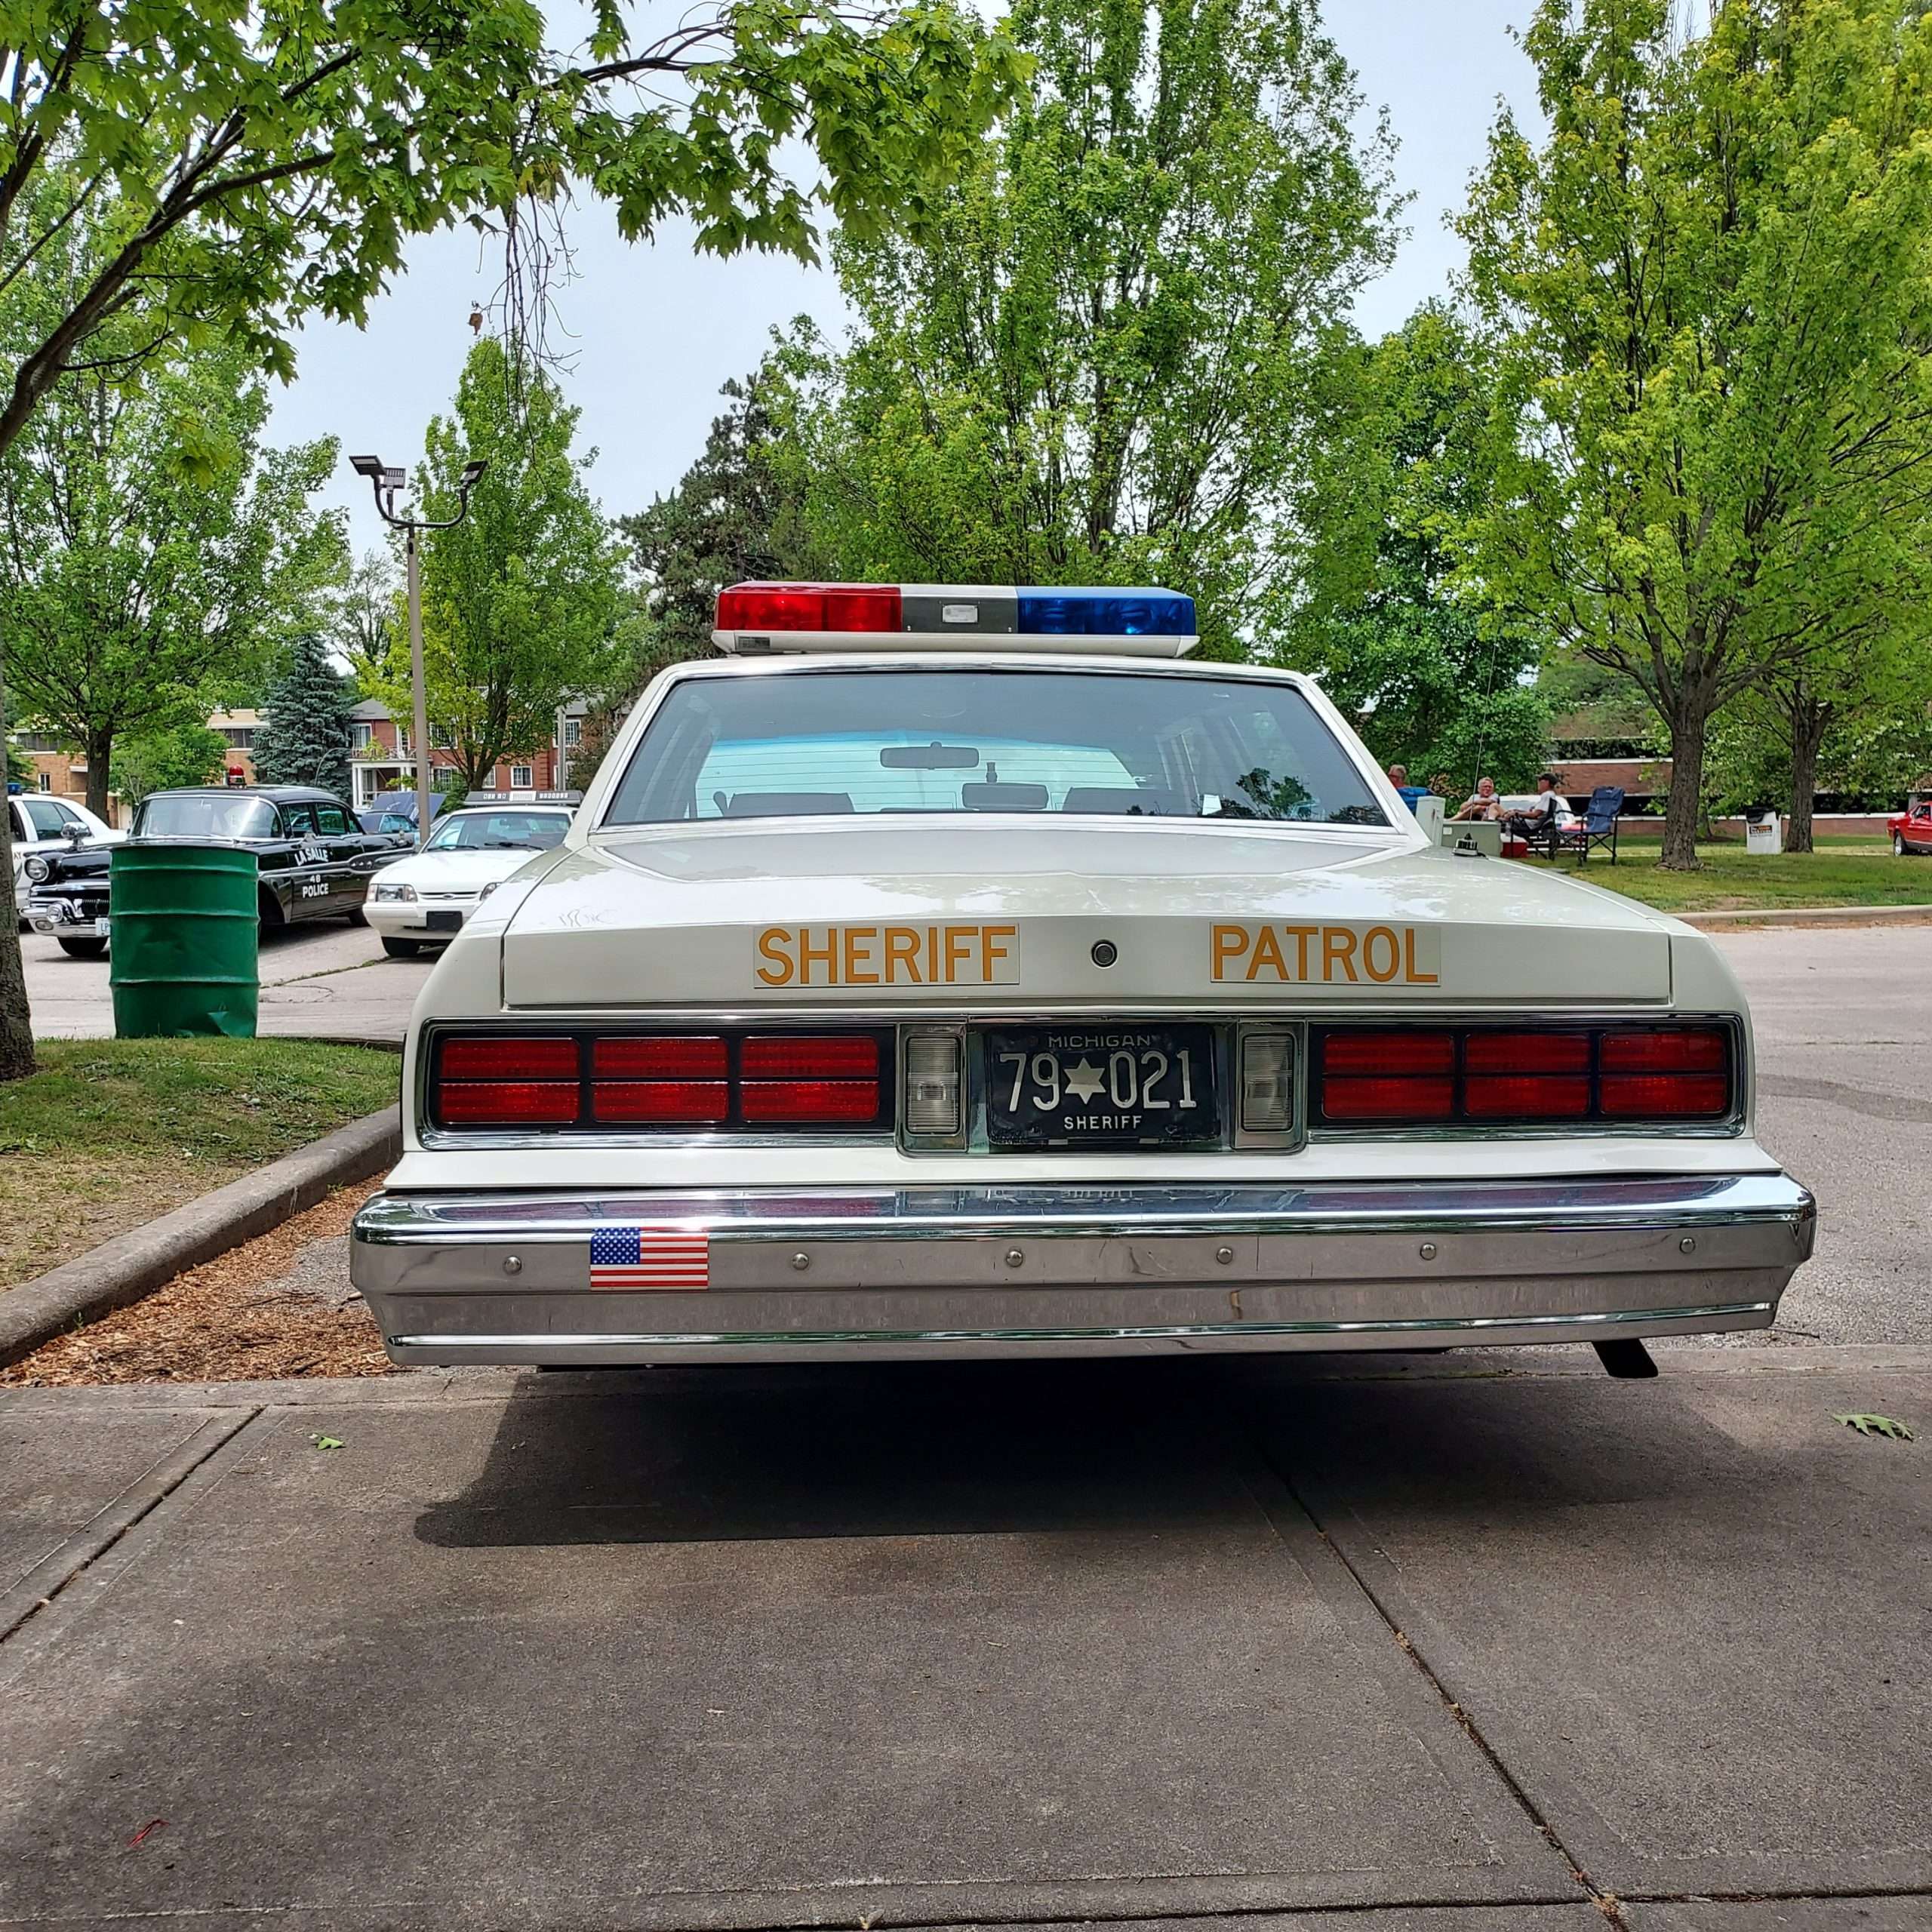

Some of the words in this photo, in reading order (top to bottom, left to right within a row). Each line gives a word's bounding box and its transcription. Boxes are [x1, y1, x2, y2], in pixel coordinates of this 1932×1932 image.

[294, 850, 307, 866] LA
[305, 848, 328, 862] SALLE
[303, 883, 328, 898] POLICE
[757, 926, 1016, 986] SHERIFF
[1212, 925, 1438, 983] PATROL
[1048, 1035, 1152, 1049] MICHIGAN
[999, 1052, 1060, 1112] 79
[1109, 1050, 1197, 1109] 021
[1063, 1115, 1143, 1130] SHERIFF
